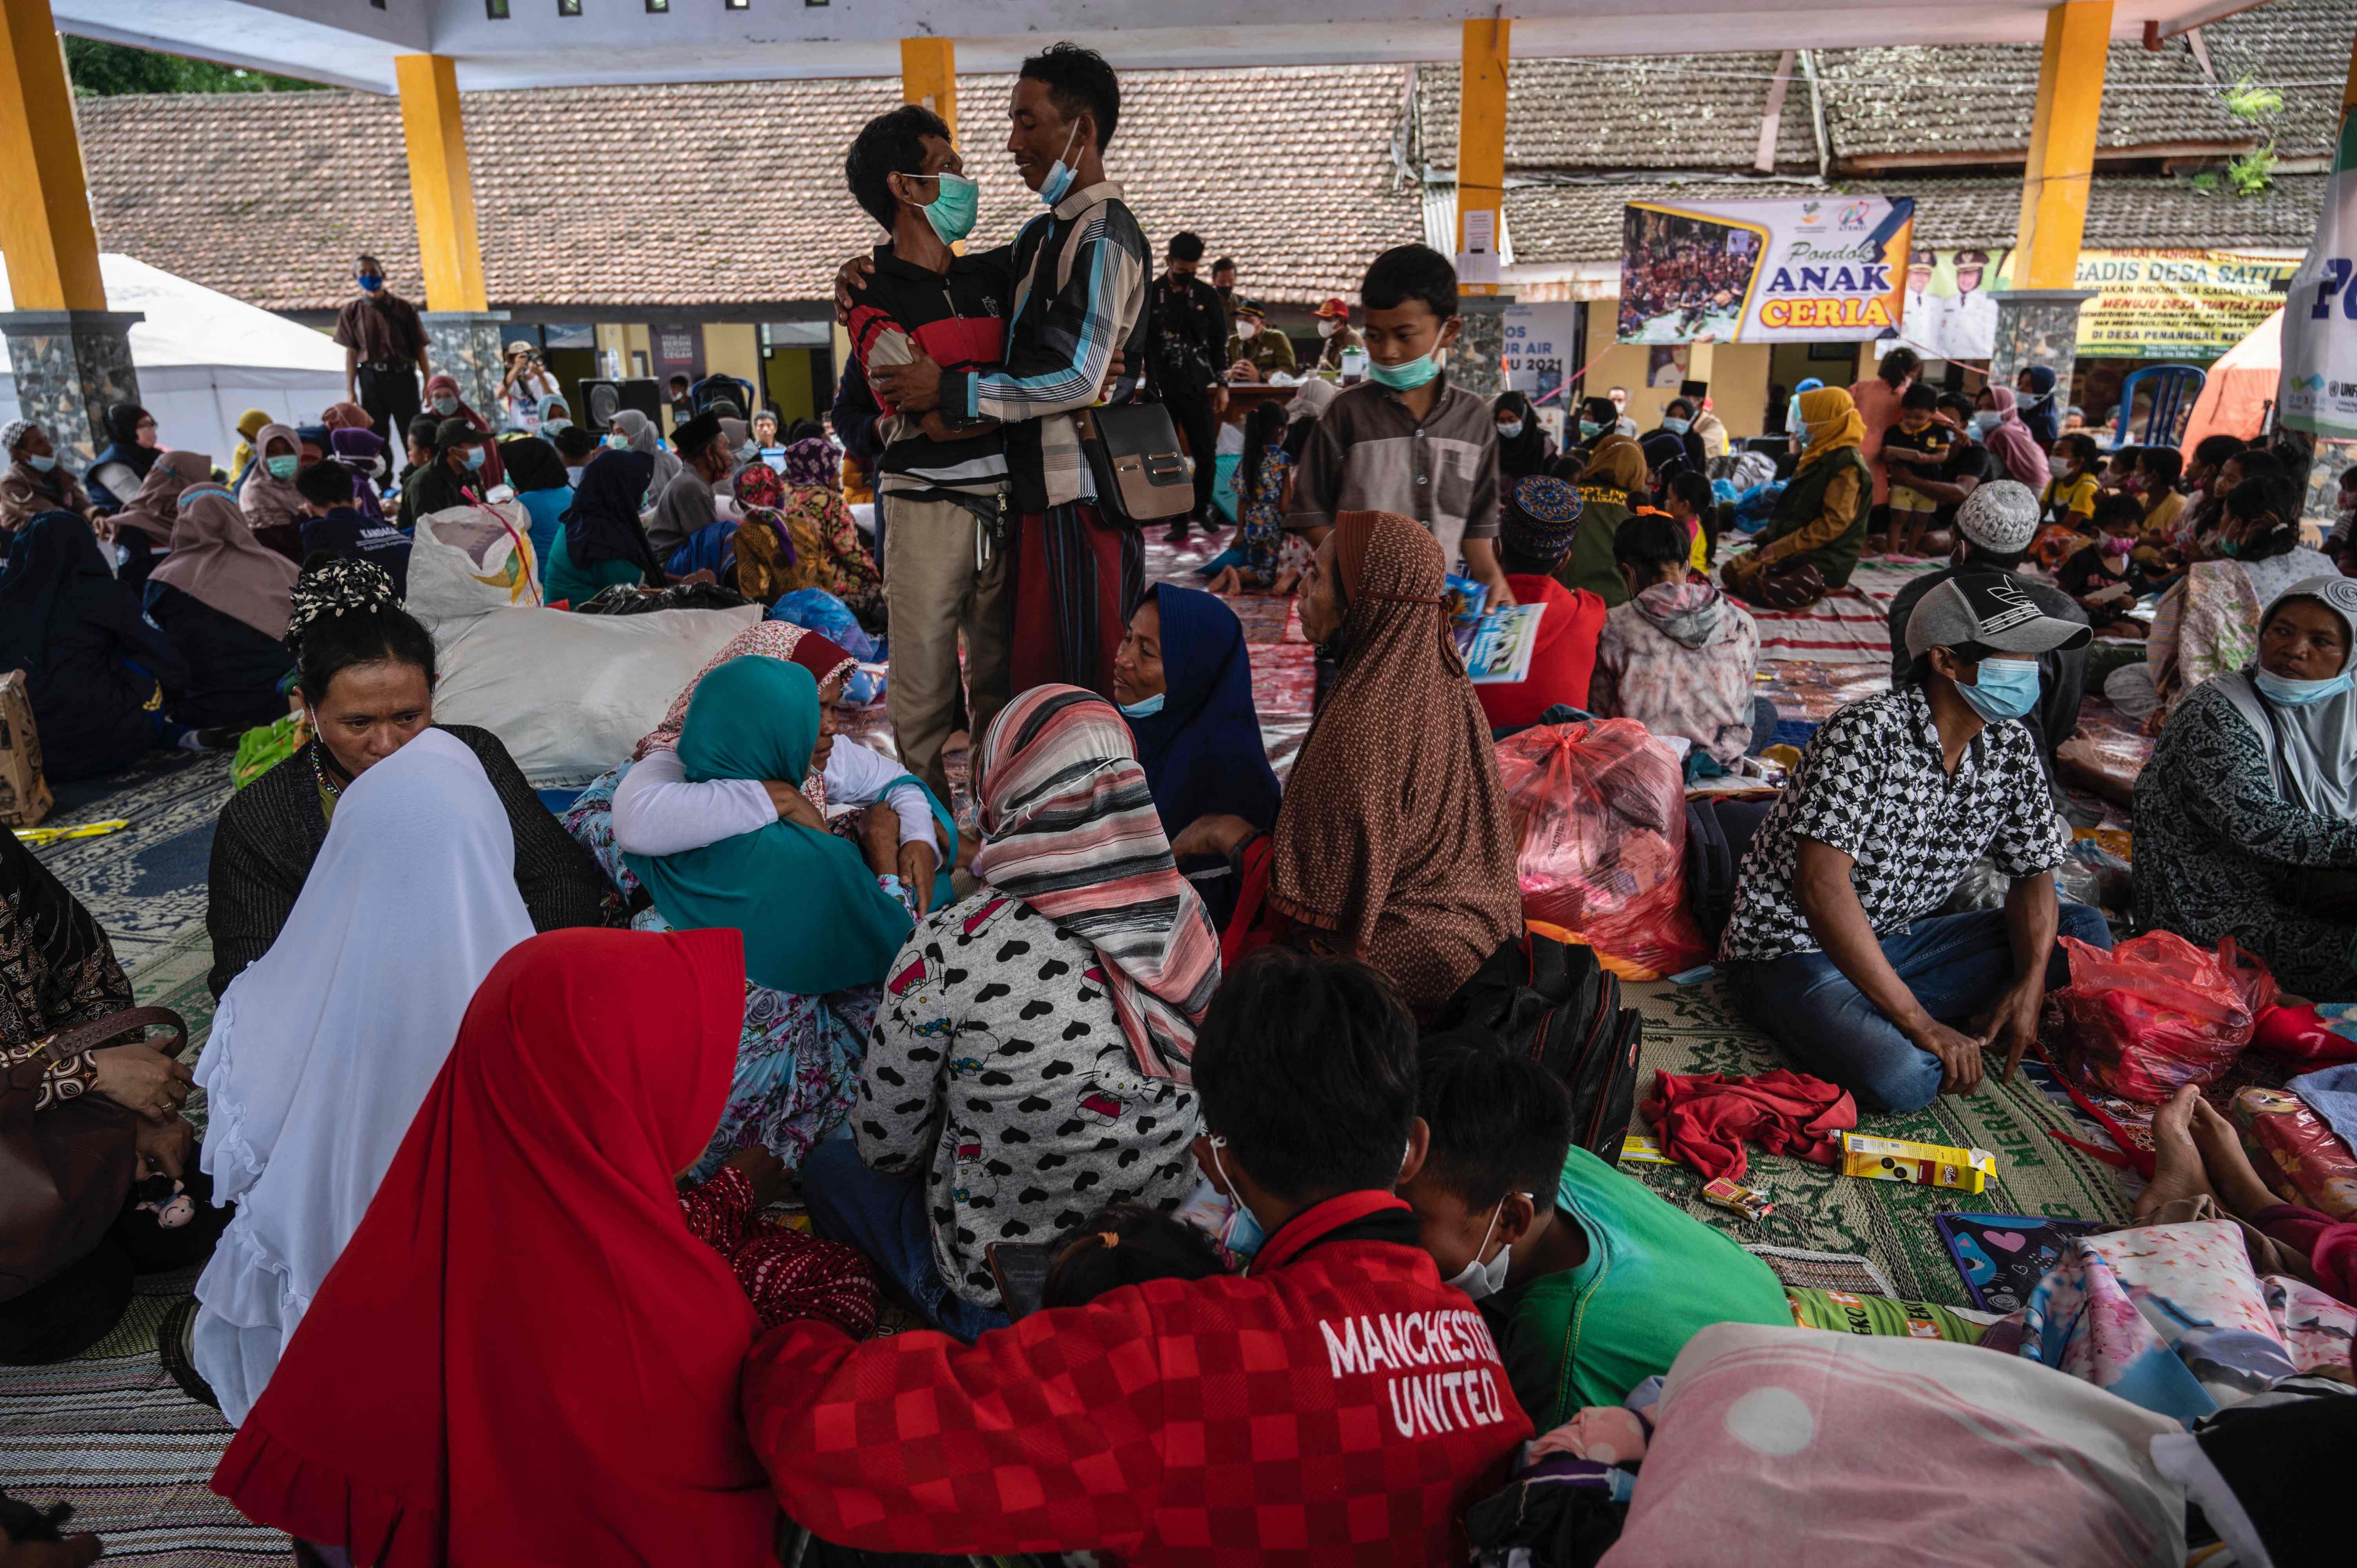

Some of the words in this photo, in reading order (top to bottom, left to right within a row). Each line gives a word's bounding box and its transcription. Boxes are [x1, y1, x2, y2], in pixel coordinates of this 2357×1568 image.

[1789, 240, 1875, 263] Pondok
[1766, 264, 1892, 293] ANAK
[2145, 263, 2209, 283] DESA
[1760, 297, 1891, 328] CERIA
[2101, 299, 2158, 308] MENUJU
[2162, 299, 2195, 309] DESA
[1505, 326, 1526, 338] OS
[2092, 330, 2102, 339] DI
[2107, 330, 2139, 339] DESA
[1526, 342, 1551, 354] AIR
[1527, 359, 1562, 370] 2021
[1944, 1165, 1957, 1186] Black
[1844, 1307, 1873, 1335] ERO
[1388, 1368, 1504, 1438] UNITED
